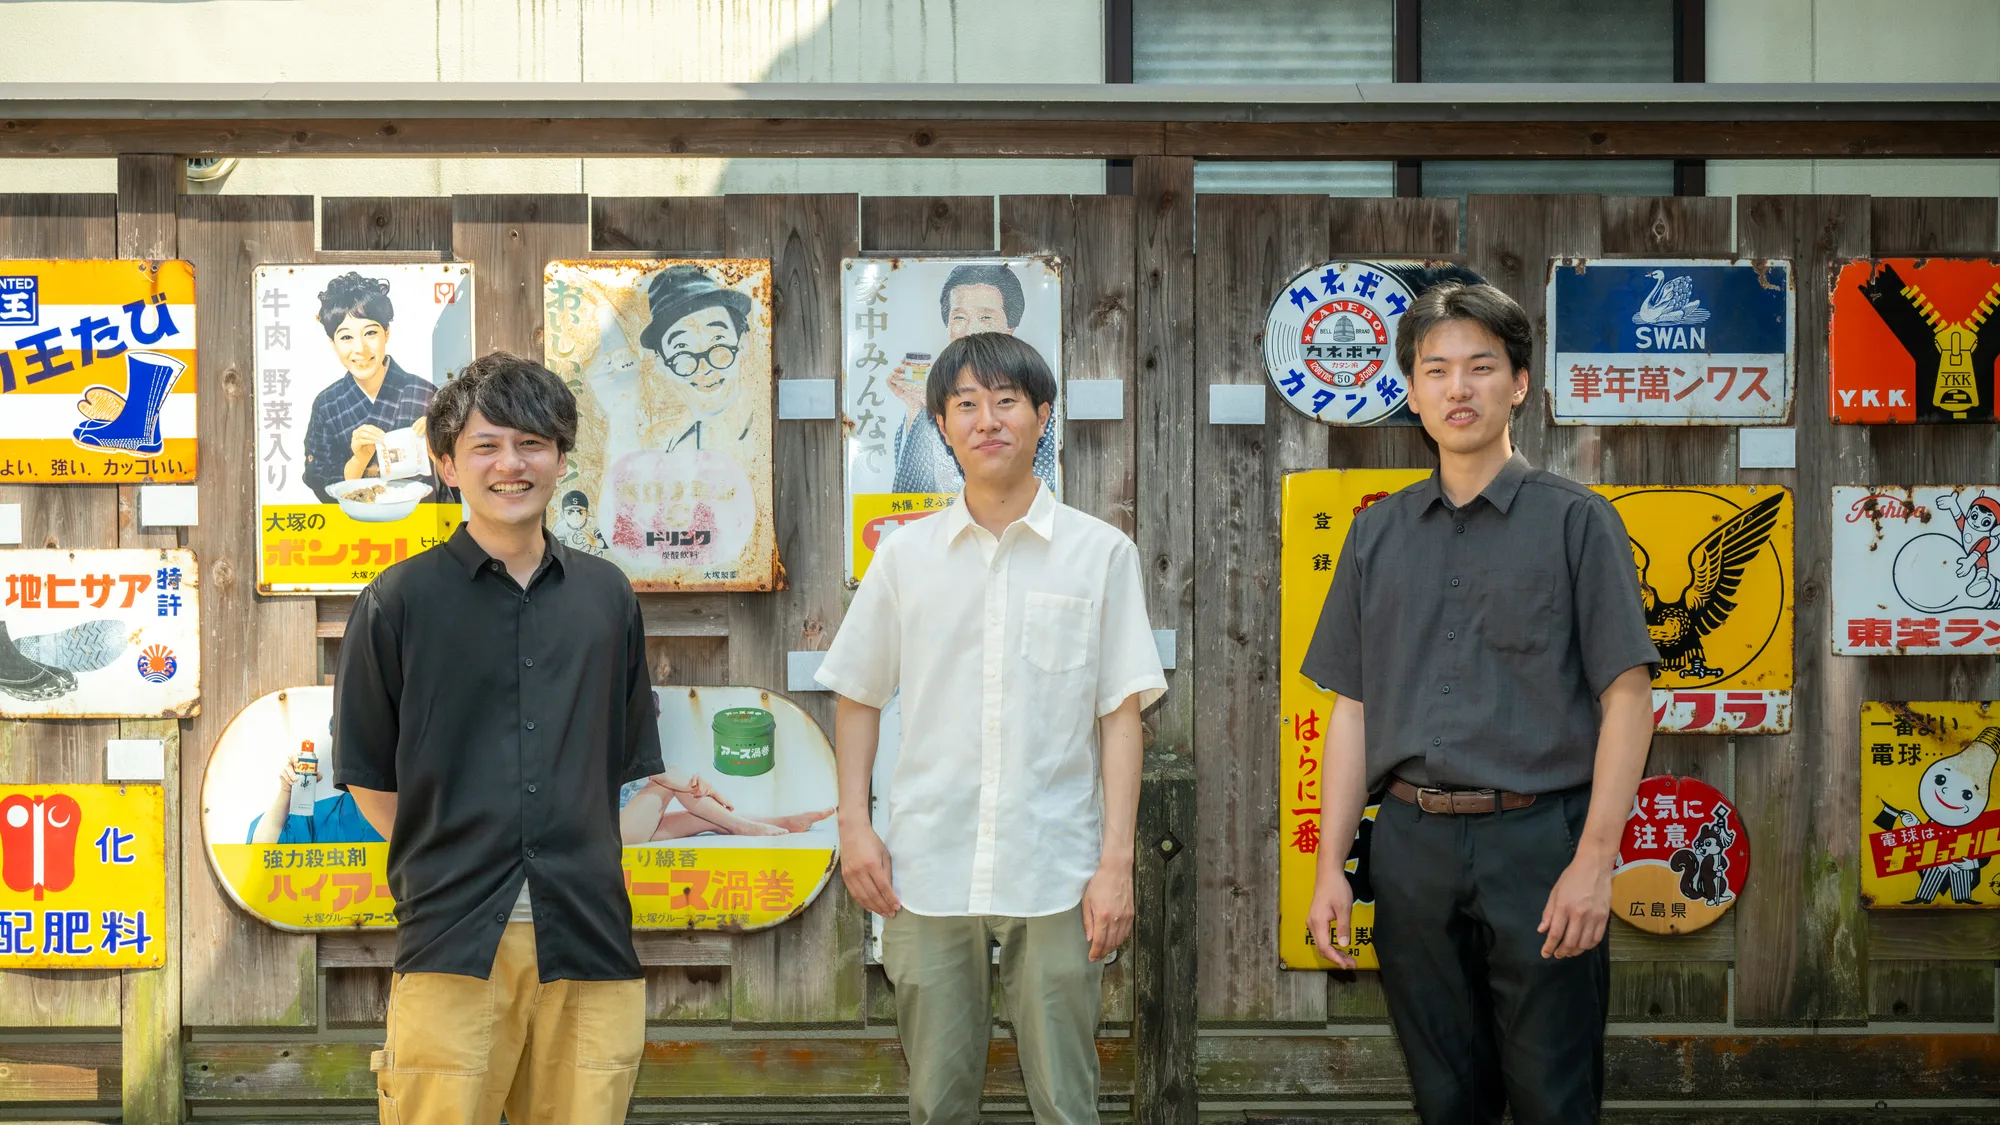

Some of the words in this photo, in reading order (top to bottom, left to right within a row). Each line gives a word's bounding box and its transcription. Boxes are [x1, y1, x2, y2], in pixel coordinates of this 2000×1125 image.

[1289, 268, 1408, 317] カネボウ
[262, 287, 292, 351] 牛肉
[1308, 302, 1382, 331] KANEBO
[1635, 326, 1706, 349] SWAN
[1306, 345, 1382, 359] カネボウ
[854, 274, 889, 475] 家中みんなで
[1337, 374, 1351, 384] 50
[1941, 374, 1971, 386] YKK
[1279, 368, 1404, 420] カタン糸
[1837, 389, 1911, 407] Y.K.K.
[263, 368, 293, 492] 野菜入り
[572, 497, 578, 505] S
[1845, 494, 1930, 523] Toshia
[265, 511, 326, 532] 大塚の
[646, 530, 711, 546] ドリンク
[661, 550, 699, 560] 炭酸飲料
[351, 571, 379, 580] 大塚グ
[703, 570, 738, 580] 大塚製薬
[156, 567, 183, 617] 特許
[1870, 713, 1959, 737] 一番よい
[720, 745, 770, 760] アース渦巻
[1289, 708, 1322, 854] はらに一番
[1627, 793, 1705, 821] 火気に
[95, 827, 135, 864] 化
[1633, 823, 1690, 849] 注意
[263, 846, 367, 869] 強力殺虫剤
[623, 869, 795, 912] ース渦巻
[1629, 901, 1687, 919] 広島県
[0, 910, 152, 955] 配肥料
